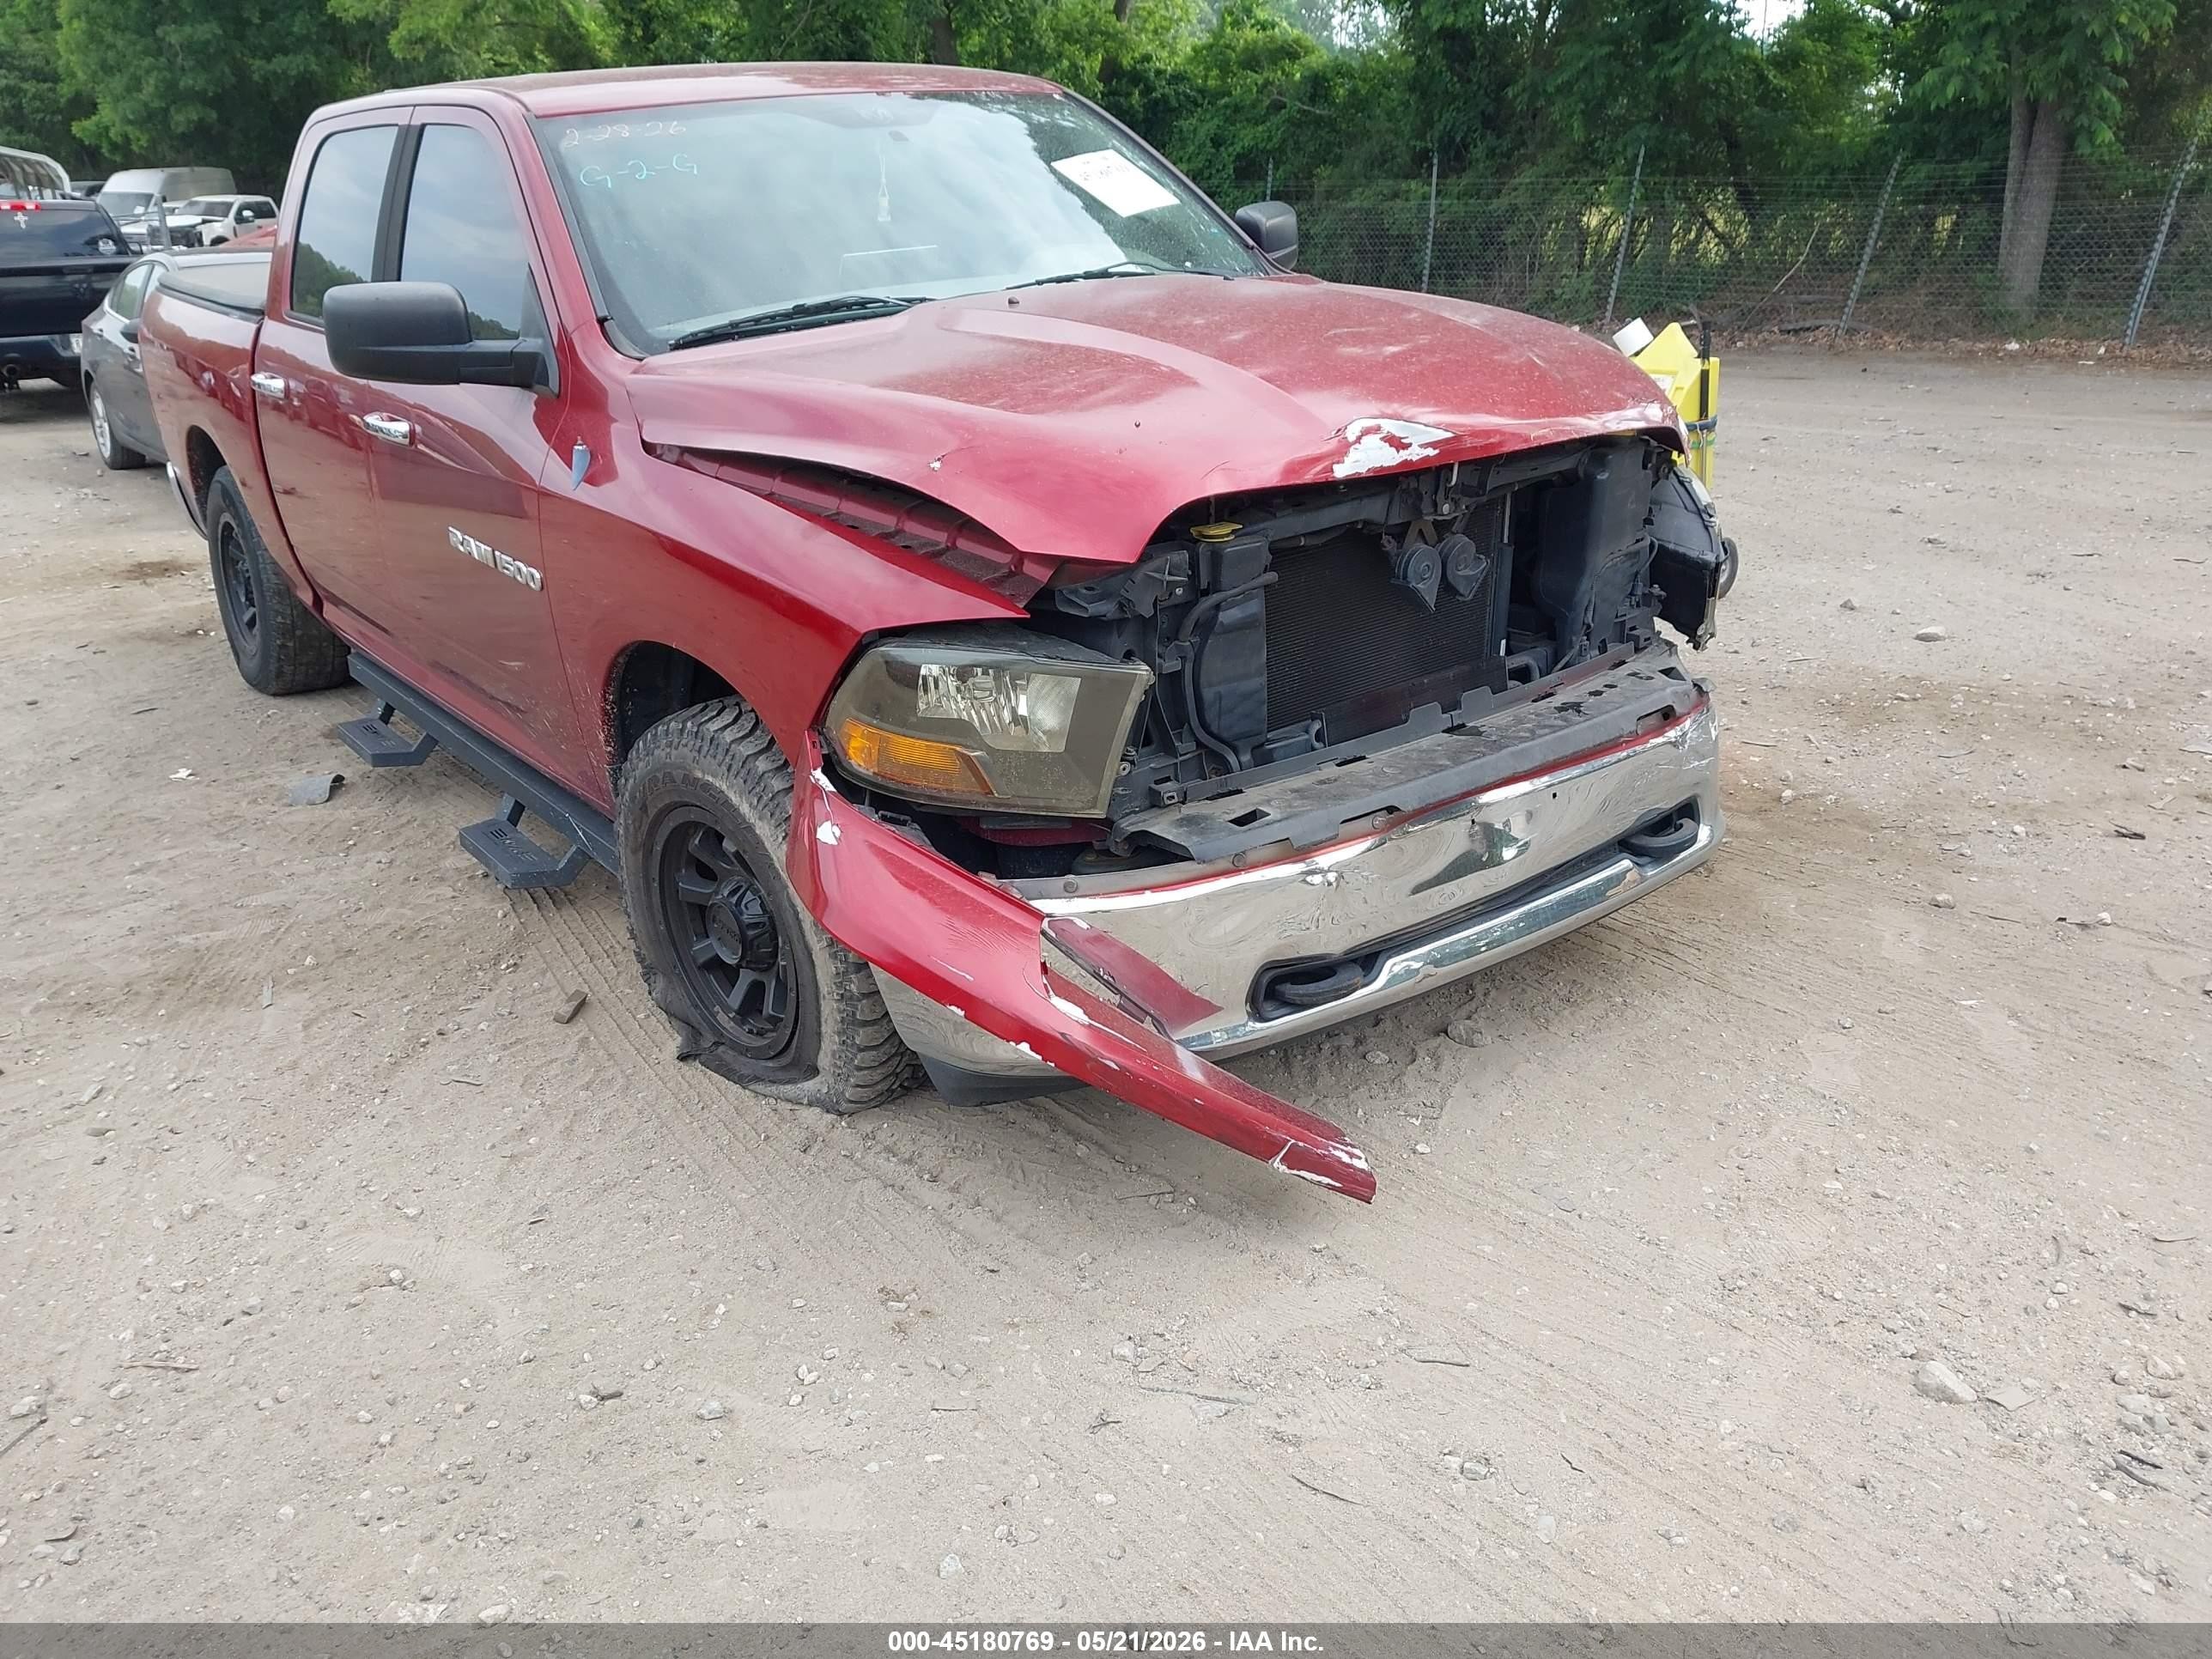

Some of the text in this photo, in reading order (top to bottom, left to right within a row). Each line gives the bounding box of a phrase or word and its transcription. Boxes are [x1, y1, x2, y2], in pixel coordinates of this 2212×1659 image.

[580, 153, 698, 188] G-2-G
[447, 526, 544, 592] RAM 1500
